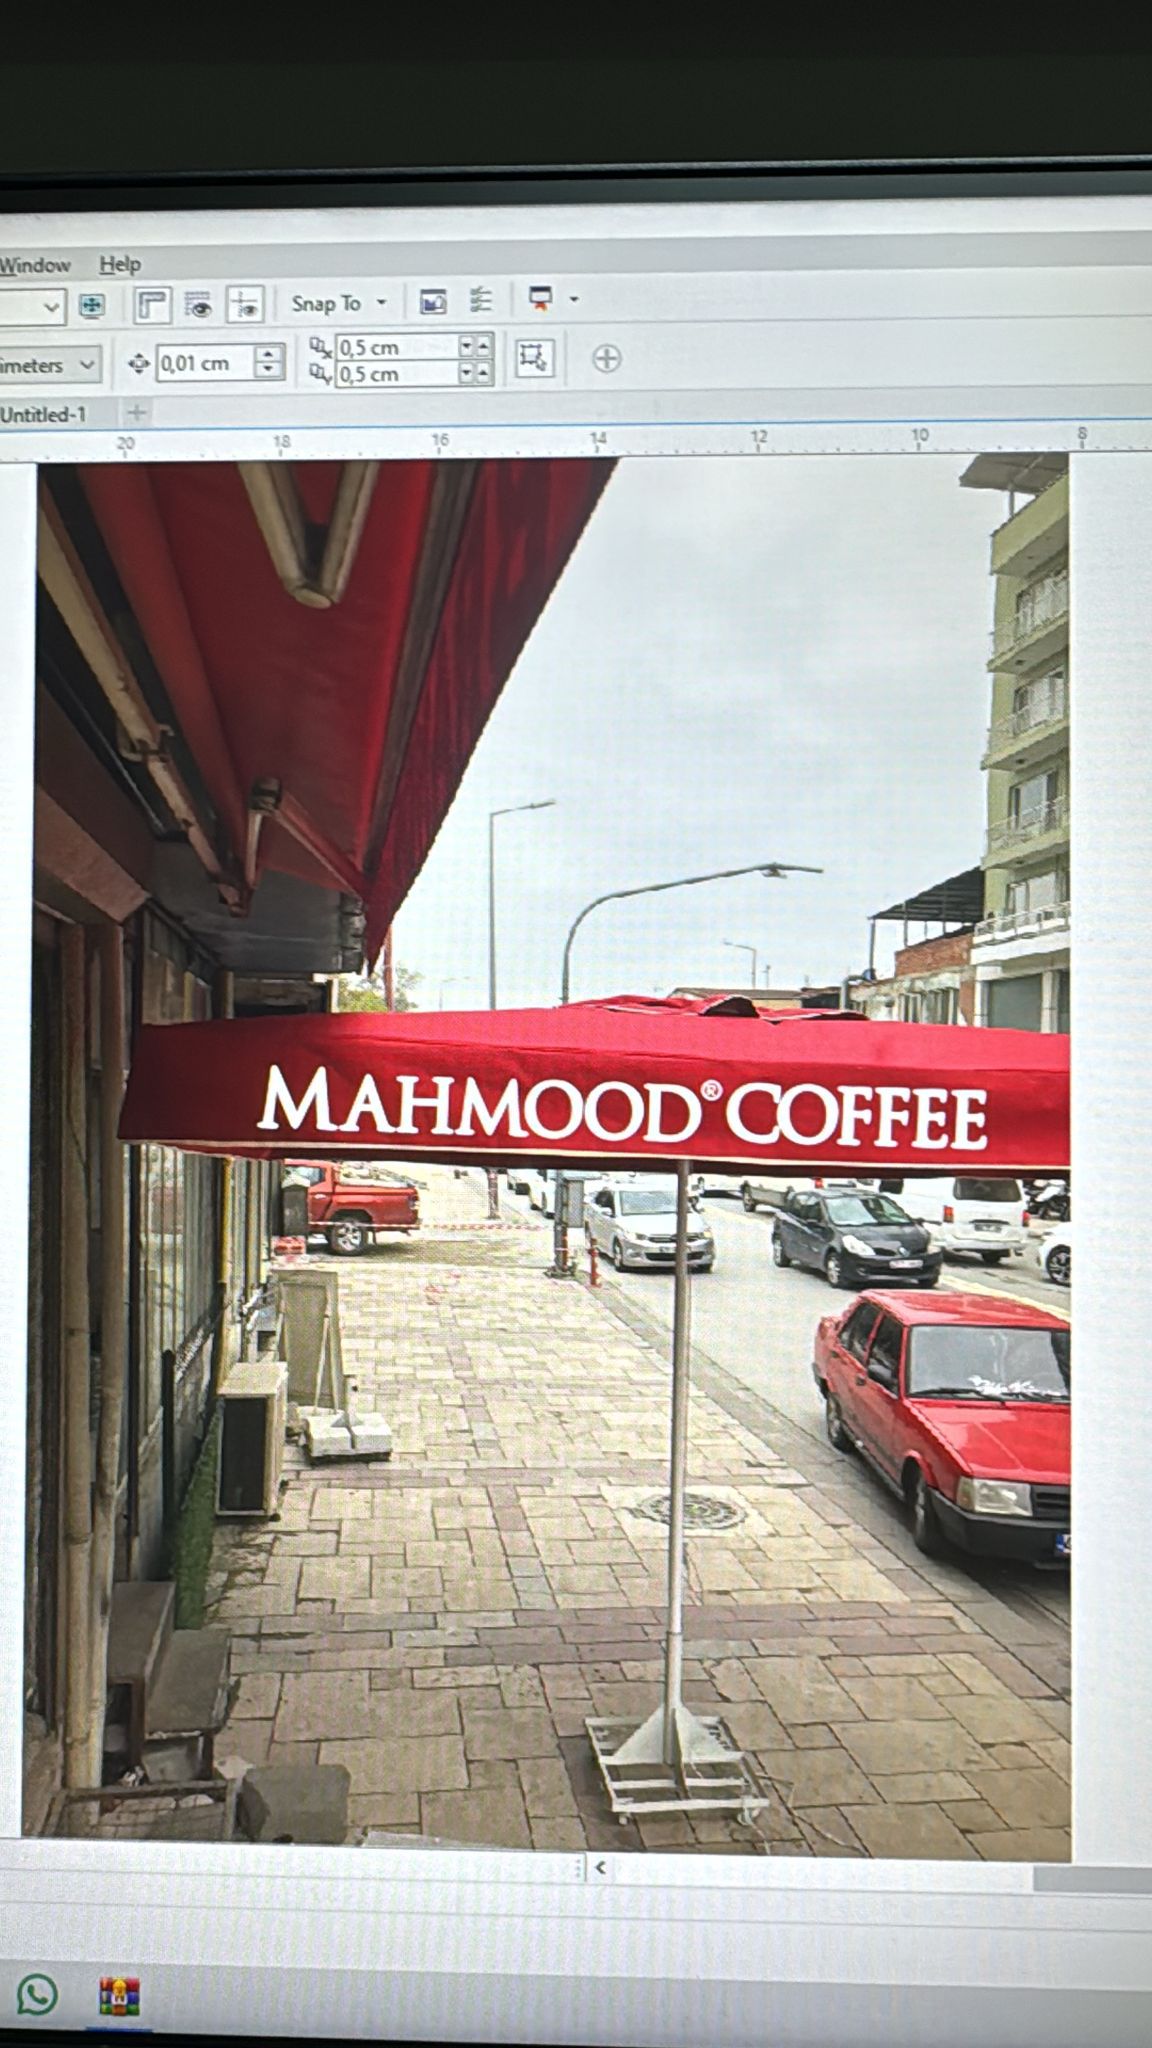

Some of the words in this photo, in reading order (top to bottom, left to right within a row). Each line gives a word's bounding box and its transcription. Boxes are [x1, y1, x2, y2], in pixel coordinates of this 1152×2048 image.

[0, 257, 71, 275] Window
[99, 255, 141, 275] Help
[292, 295, 336, 315] Snap
[341, 294, 361, 312] To
[339, 340, 365, 357] 0,5
[371, 343, 399, 355] cm
[160, 355, 195, 373] 0,01
[202, 358, 229, 372] cm
[339, 366, 365, 383] 0,5
[371, 369, 399, 381] cm
[0, 406, 86, 423] Untitled-1
[117, 436, 135, 450] 20
[274, 435, 291, 448] 18
[432, 434, 449, 447] 16
[590, 432, 607, 445] 14
[750, 430, 767, 443] 12
[911, 428, 929, 442] 10
[1077, 427, 1088, 440] 8
[725, 1082, 988, 1150] COFFEE
